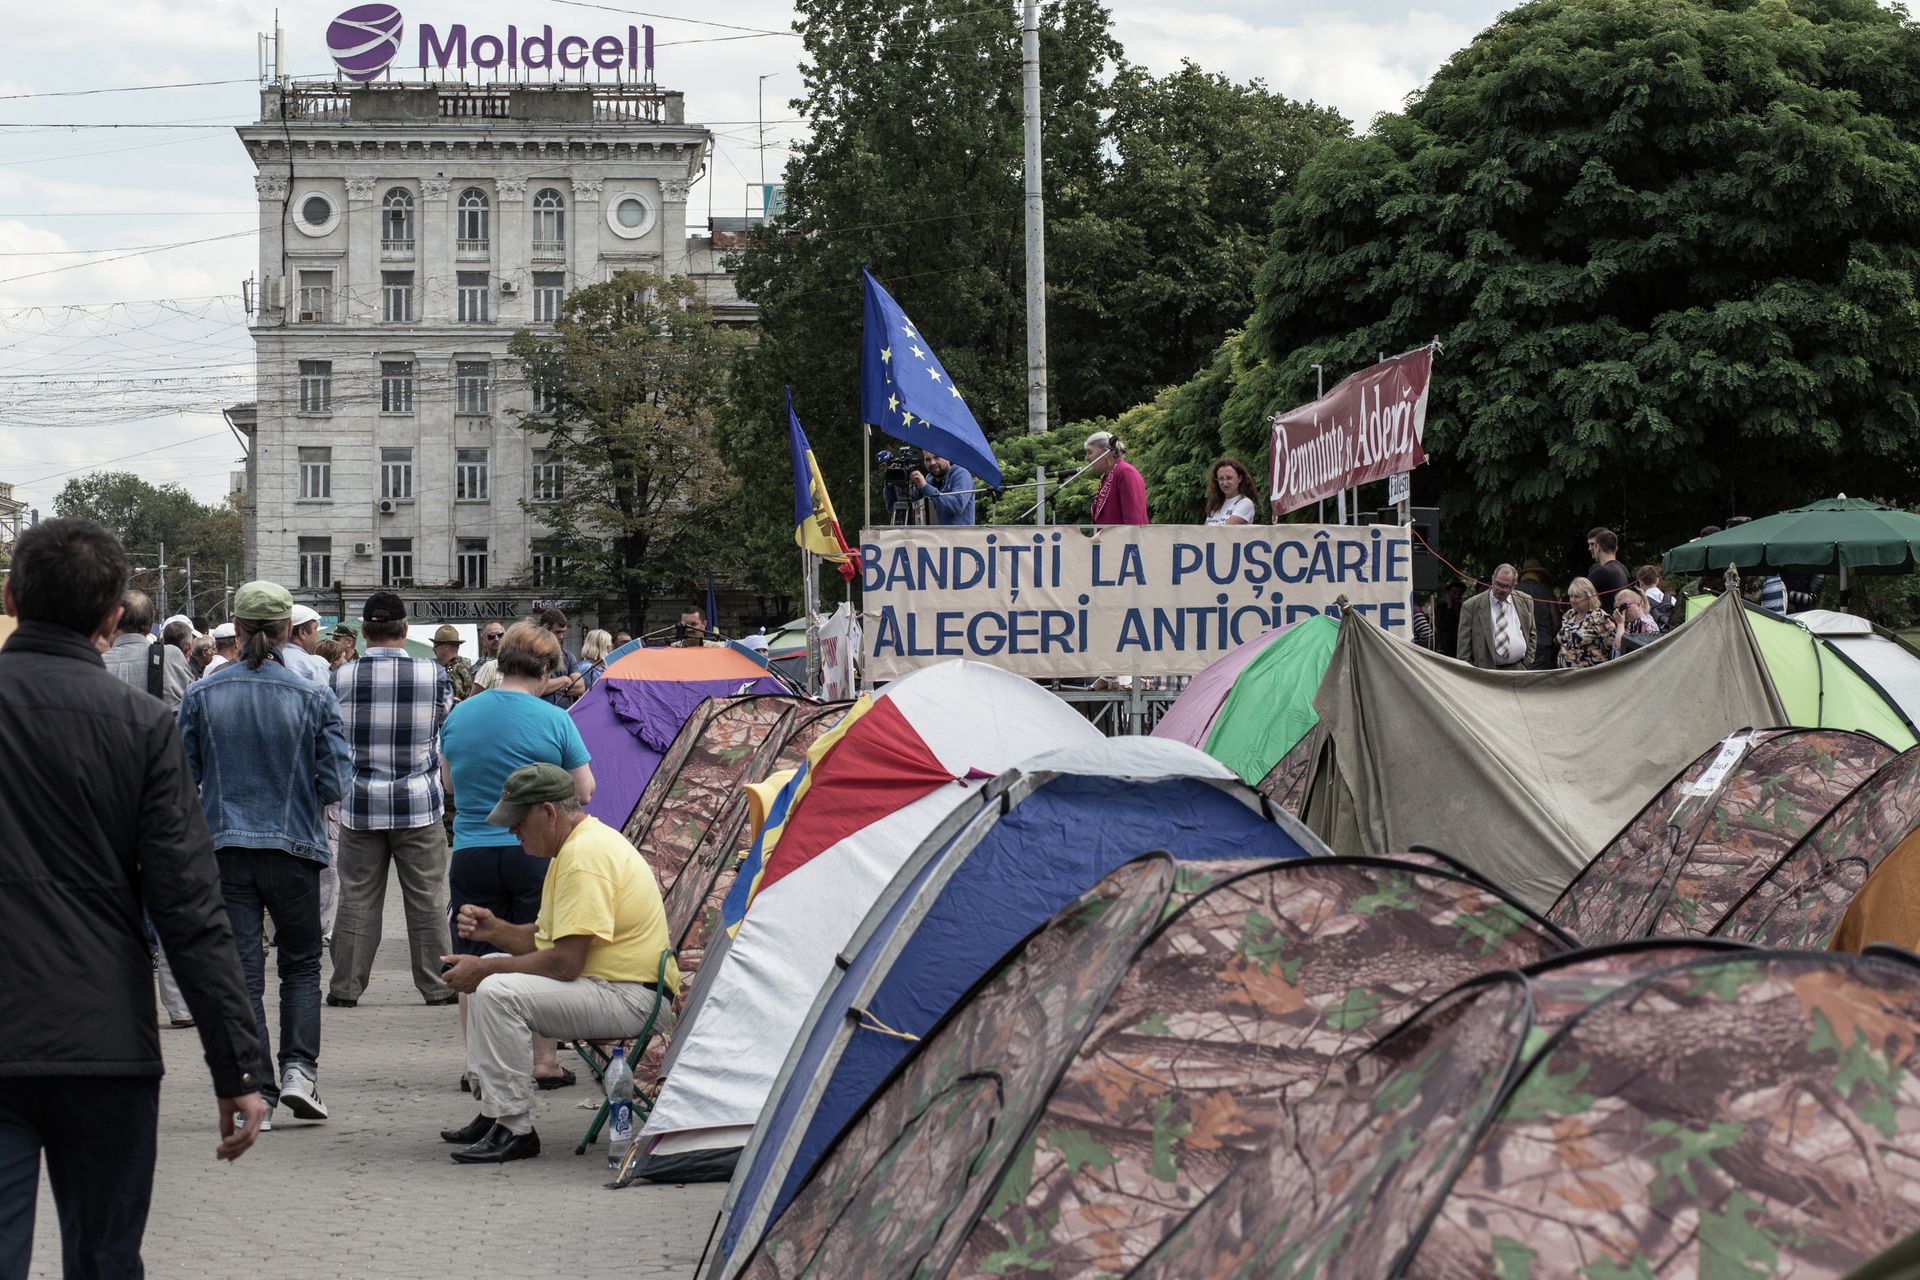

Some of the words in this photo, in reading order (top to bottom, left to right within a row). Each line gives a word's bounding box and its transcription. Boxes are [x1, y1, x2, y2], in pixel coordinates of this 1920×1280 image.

[419, 23, 654, 69] Moldcell
[1270, 413, 1344, 501] Demnitate
[1092, 543, 1146, 586] LA
[411, 600, 518, 619] UNIBANK
[873, 593, 1089, 657] ALEGERI
